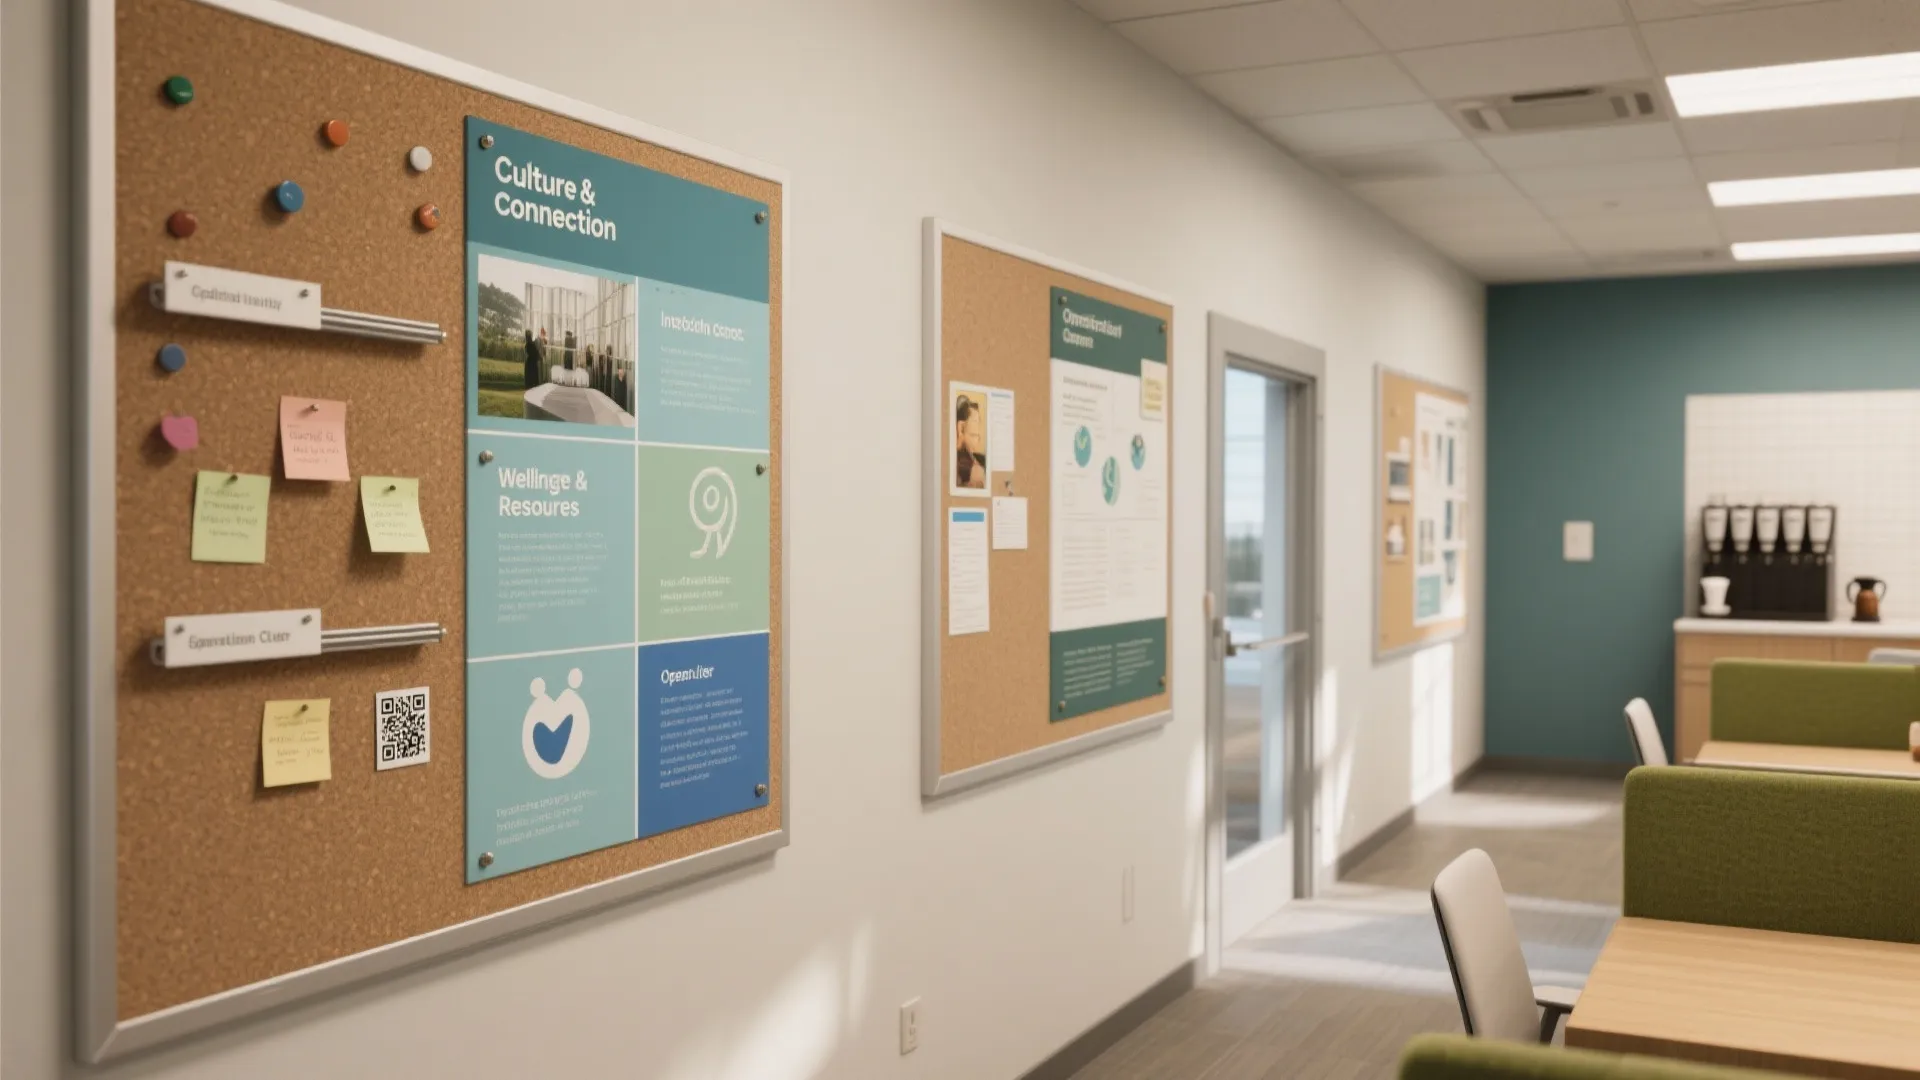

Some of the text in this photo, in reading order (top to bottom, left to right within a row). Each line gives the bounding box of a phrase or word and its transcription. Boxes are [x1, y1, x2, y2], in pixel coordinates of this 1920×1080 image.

[495, 156, 596, 206] Culture &
[495, 191, 617, 241] Connection
[575, 470, 588, 491] &
[499, 495, 580, 517] Resoures
